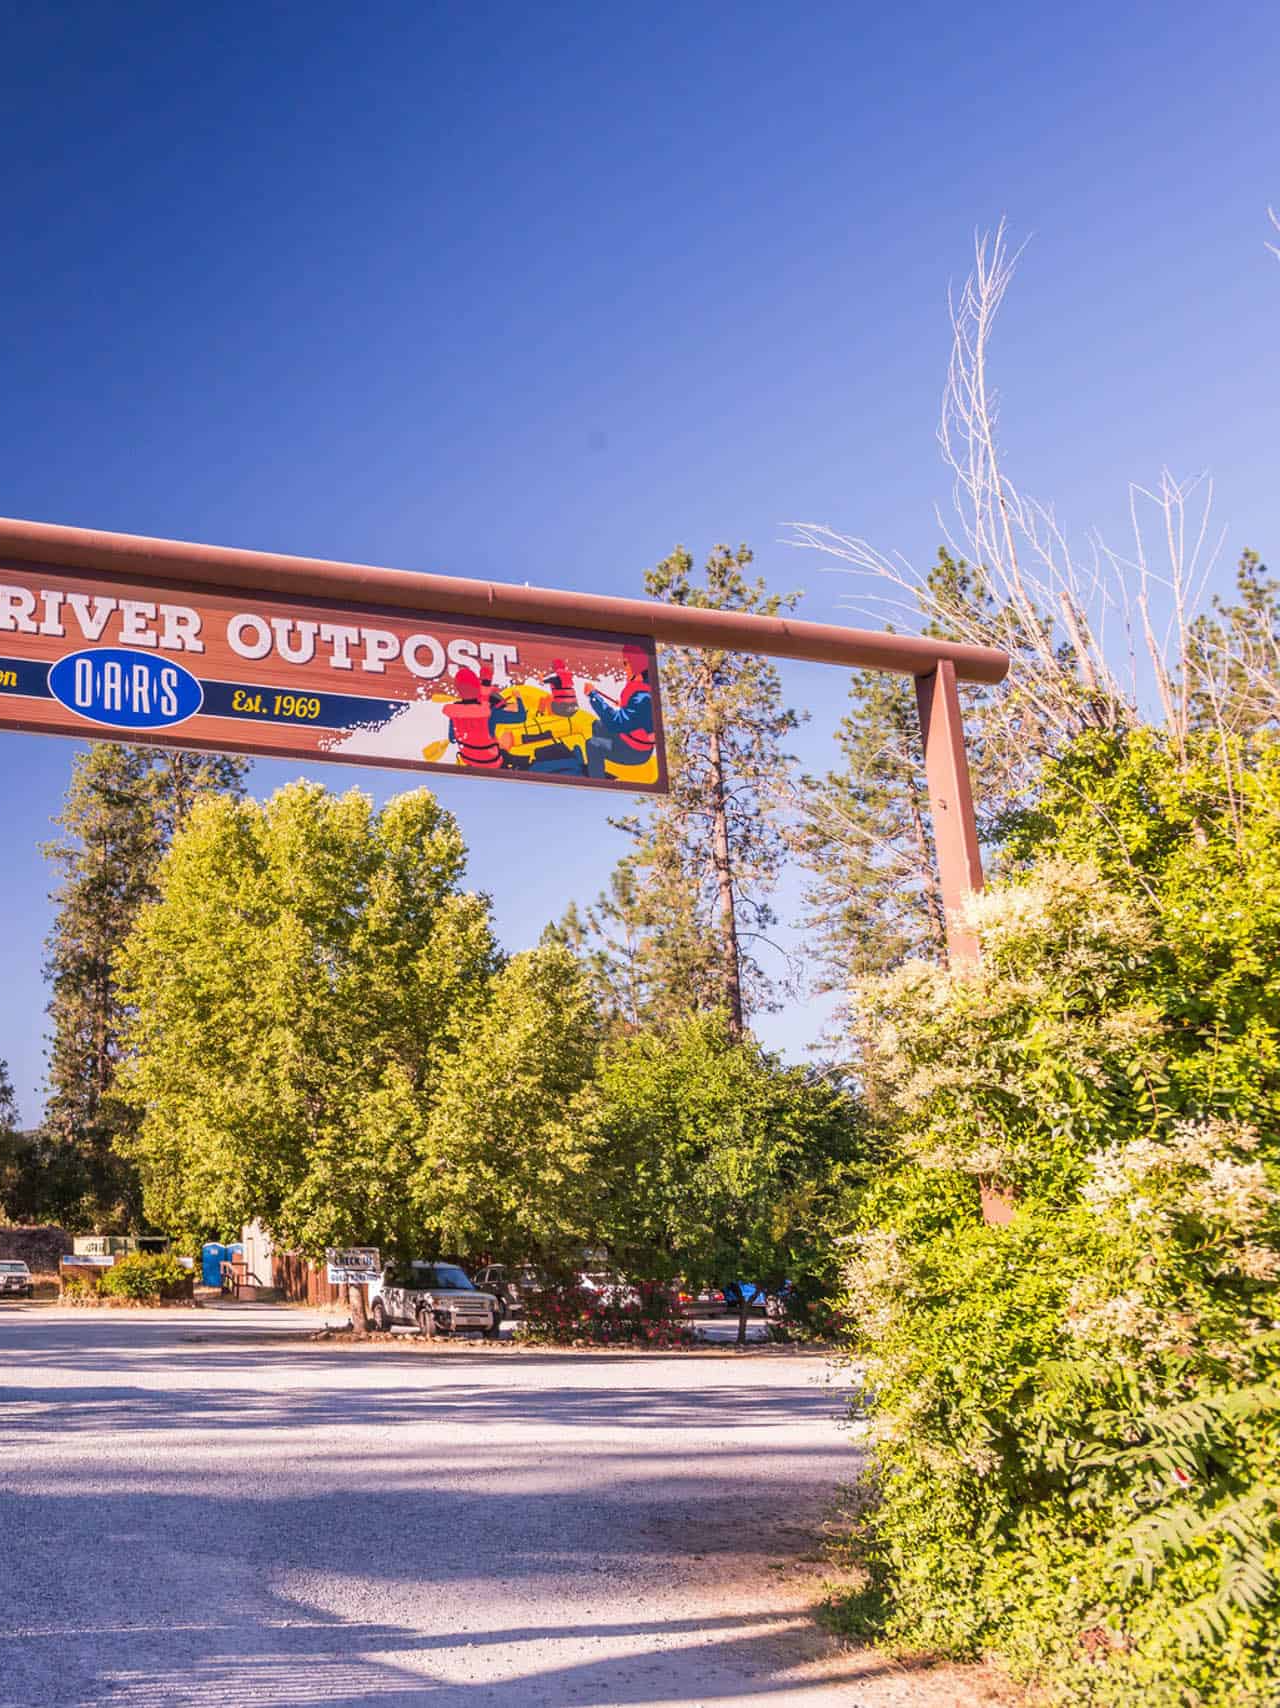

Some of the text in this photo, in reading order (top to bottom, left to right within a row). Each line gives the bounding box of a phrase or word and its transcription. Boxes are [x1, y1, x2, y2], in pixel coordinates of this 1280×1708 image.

[226, 612, 518, 690] OUTPOST
[231, 690, 321, 719] Est. 1969
